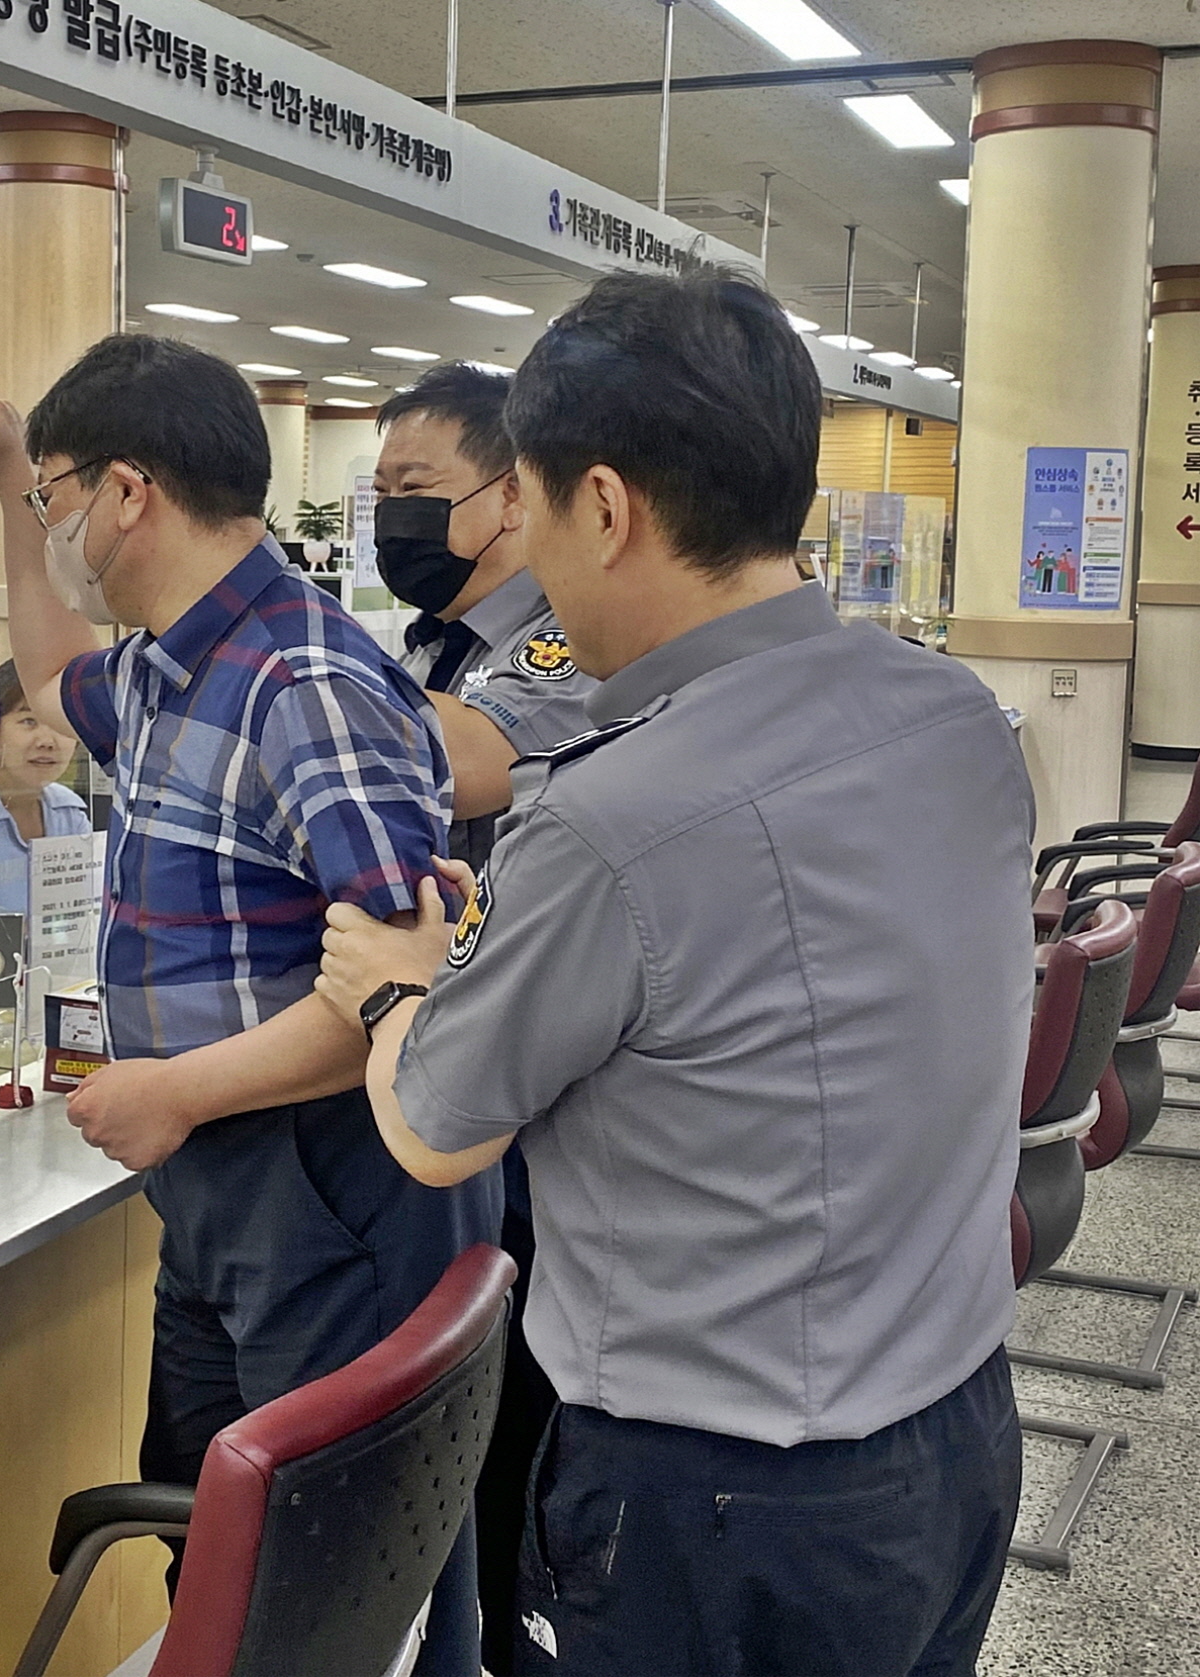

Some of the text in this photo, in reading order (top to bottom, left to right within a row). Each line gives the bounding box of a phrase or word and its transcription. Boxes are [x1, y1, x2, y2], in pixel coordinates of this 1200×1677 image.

[222, 205, 236, 247] 2
[549, 188, 564, 233] 3.
[565, 197, 633, 258] 가족관계등록
[1034, 467, 1079, 483] 안심상속
